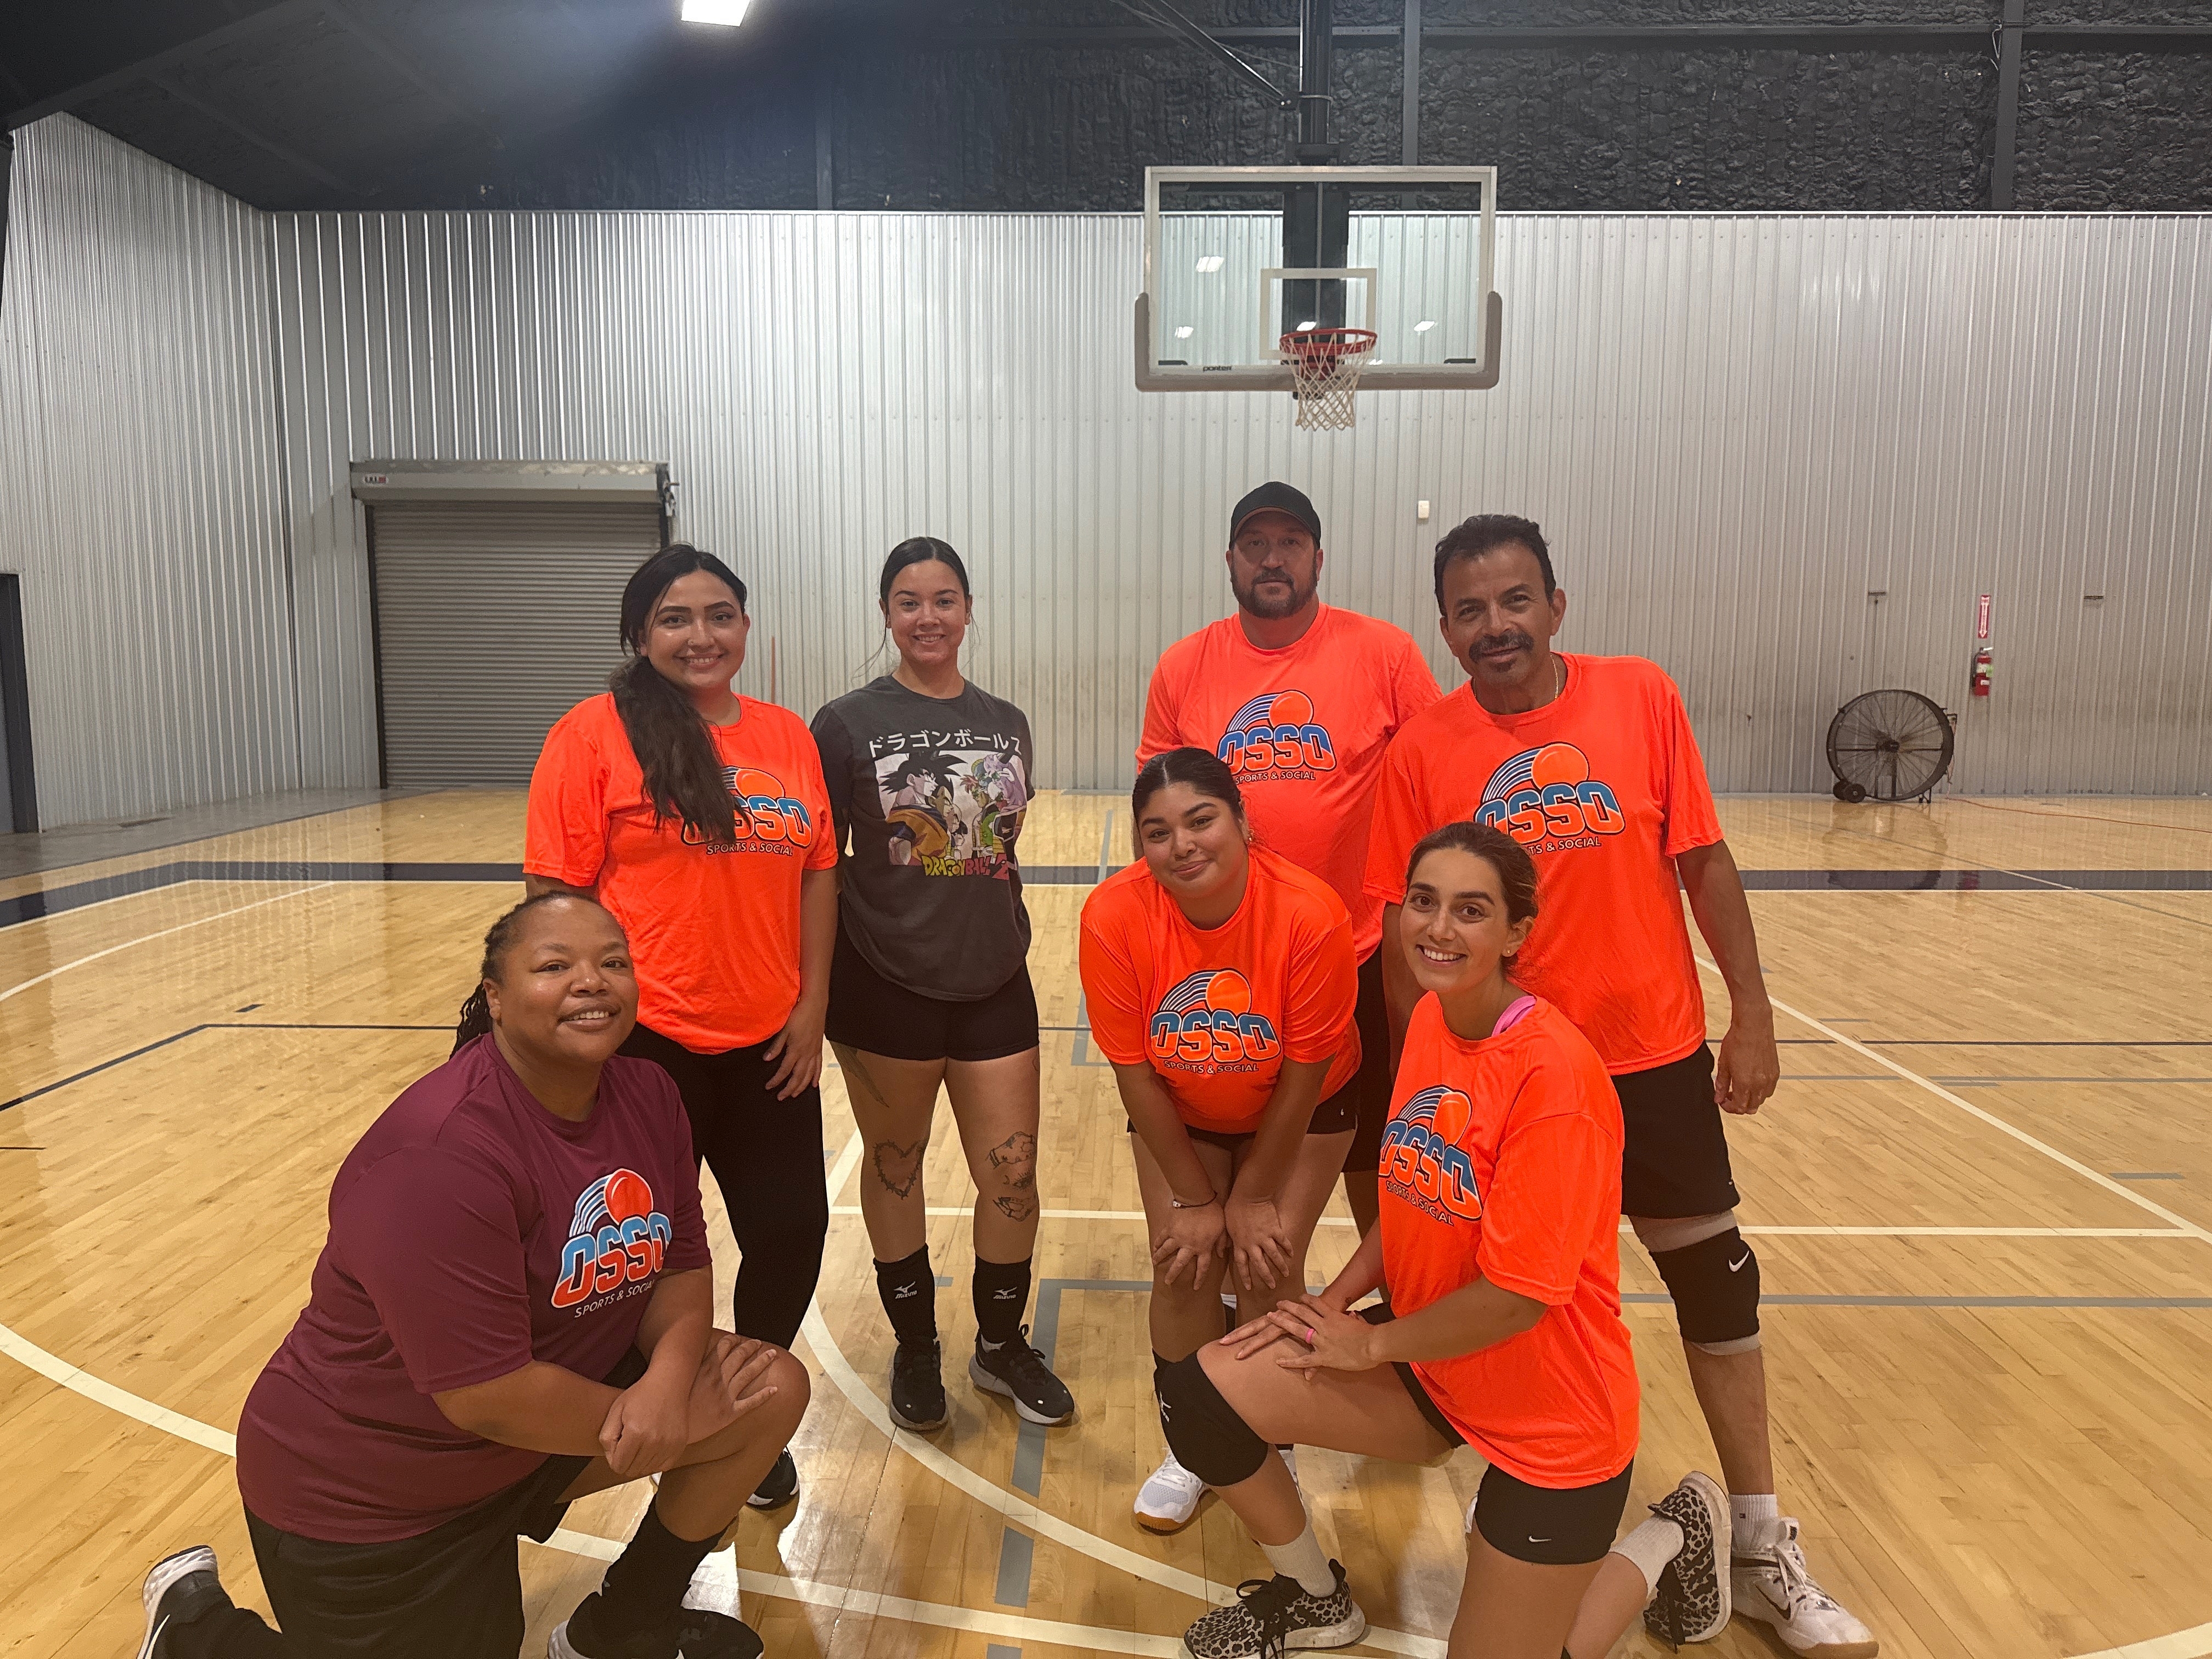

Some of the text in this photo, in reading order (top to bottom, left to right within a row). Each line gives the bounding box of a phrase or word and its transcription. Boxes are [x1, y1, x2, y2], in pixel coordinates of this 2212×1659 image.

[1216, 723, 1337, 777] OSSO
[1234, 770, 1316, 785] SPORTS & SOCIAL
[681, 794, 813, 849] SSO
[1547, 842, 1556, 852] &
[1558, 836, 1601, 850] SOCIAL
[706, 842, 747, 855] SPORTS
[749, 842, 757, 851] &
[1150, 1009, 1282, 1063] OSSO
[1164, 1060, 1259, 1074] SPORTS & SOCIAL
[1379, 1119, 1483, 1221] OSSO
[1386, 1181, 1454, 1226] SPORTS & SOCIAL
[551, 1212, 672, 1309] OSSO
[574, 1295, 614, 1318] SPORTS
[617, 1290, 624, 1301] &
